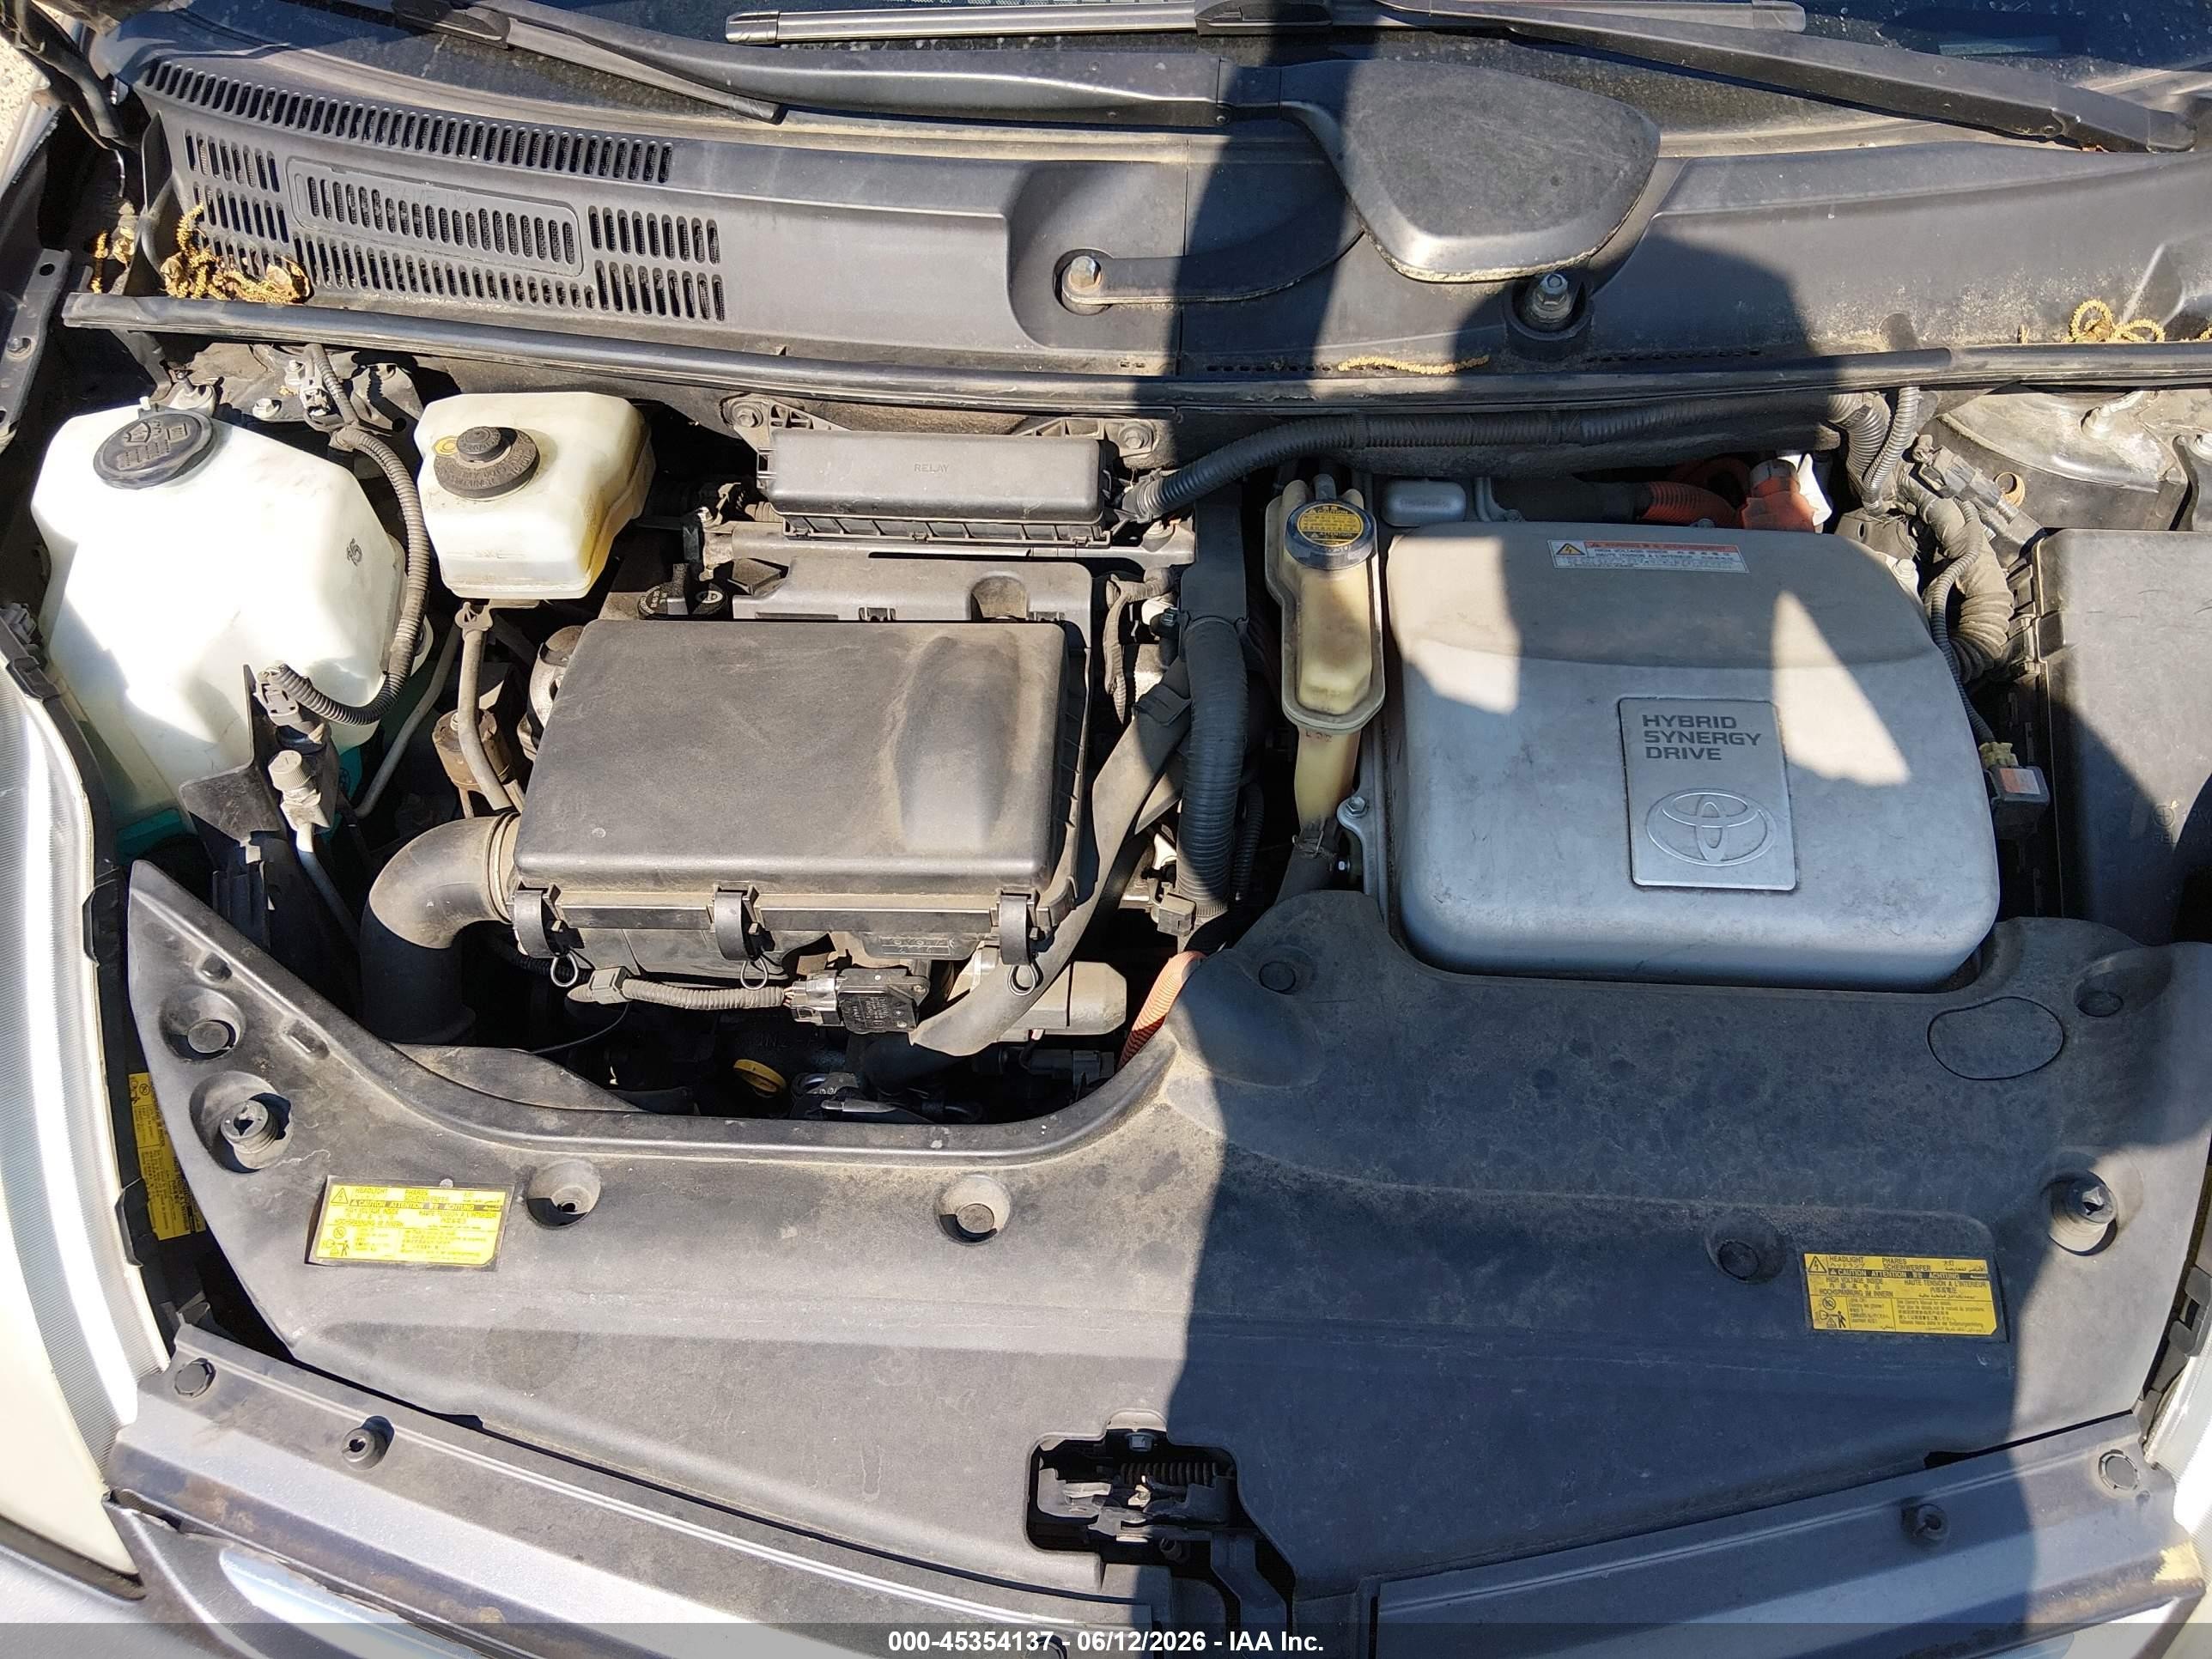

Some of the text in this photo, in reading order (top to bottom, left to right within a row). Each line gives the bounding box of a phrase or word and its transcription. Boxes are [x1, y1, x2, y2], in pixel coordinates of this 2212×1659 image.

[914, 463, 950, 473] RELAY
[1643, 714, 1737, 729] HYBRID
[1644, 731, 1762, 745] SYNERGY
[1645, 747, 1722, 761] DRIVE
[391, 1200, 424, 1209] ATTENTION
[1883, 1263, 1931, 1272] SCHEINWERFER
[1820, 1288, 1863, 1297] HOCHSPANNUNG
